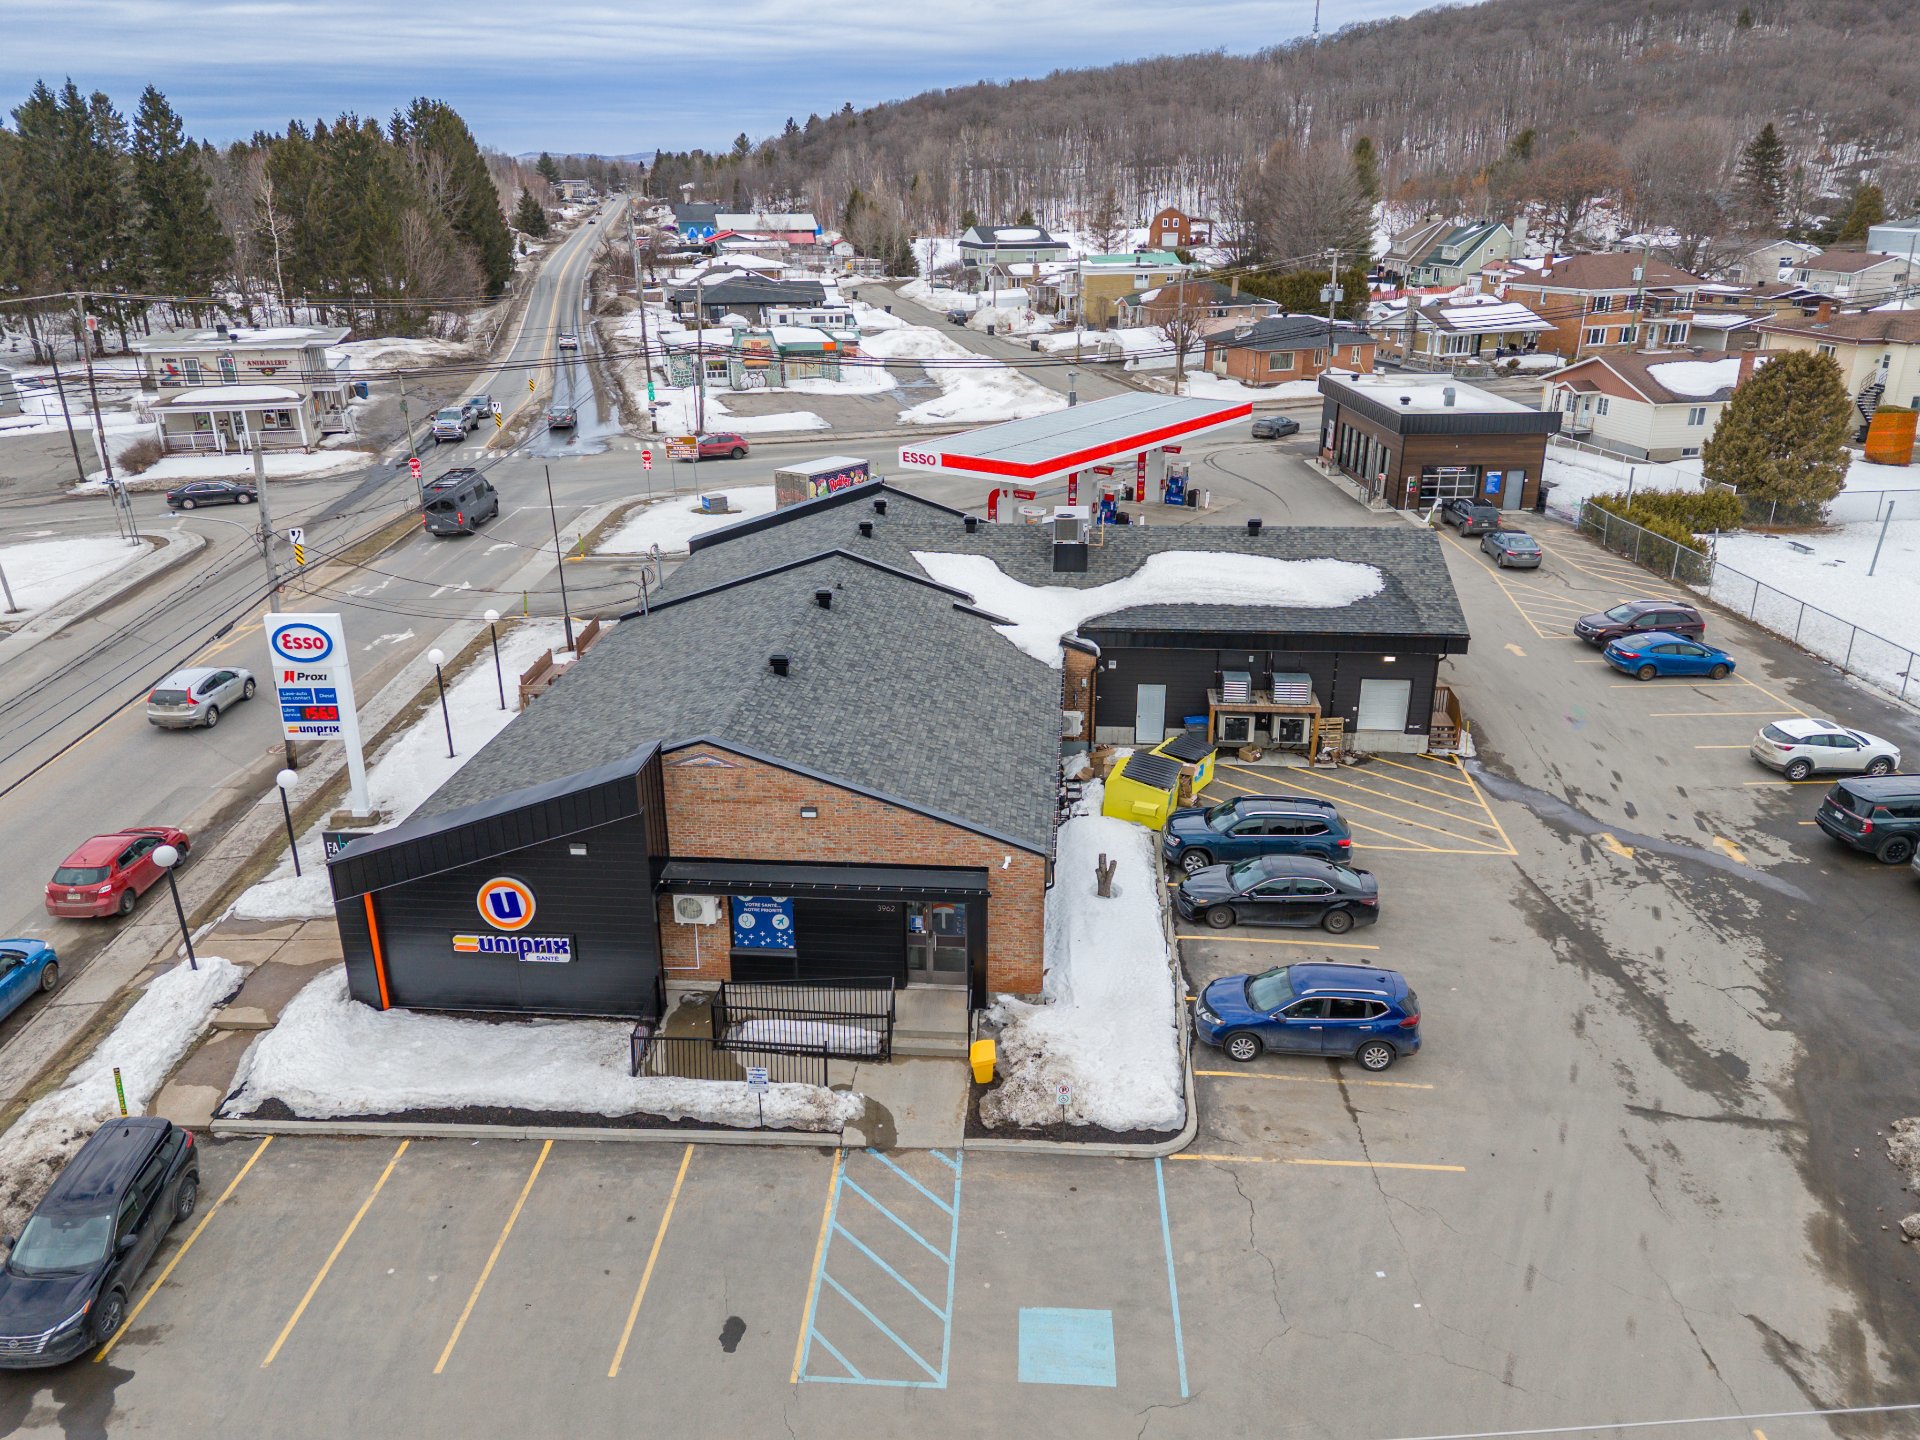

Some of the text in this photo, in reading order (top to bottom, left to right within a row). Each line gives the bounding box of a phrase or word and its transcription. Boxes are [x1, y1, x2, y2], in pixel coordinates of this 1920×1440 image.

[902, 451, 937, 466] ESSO
[281, 633, 324, 650] Esso
[297, 673, 327, 681] Proxi
[299, 725, 340, 737] uniprix
[877, 904, 896, 912] 3962
[478, 936, 570, 961] uniprix
